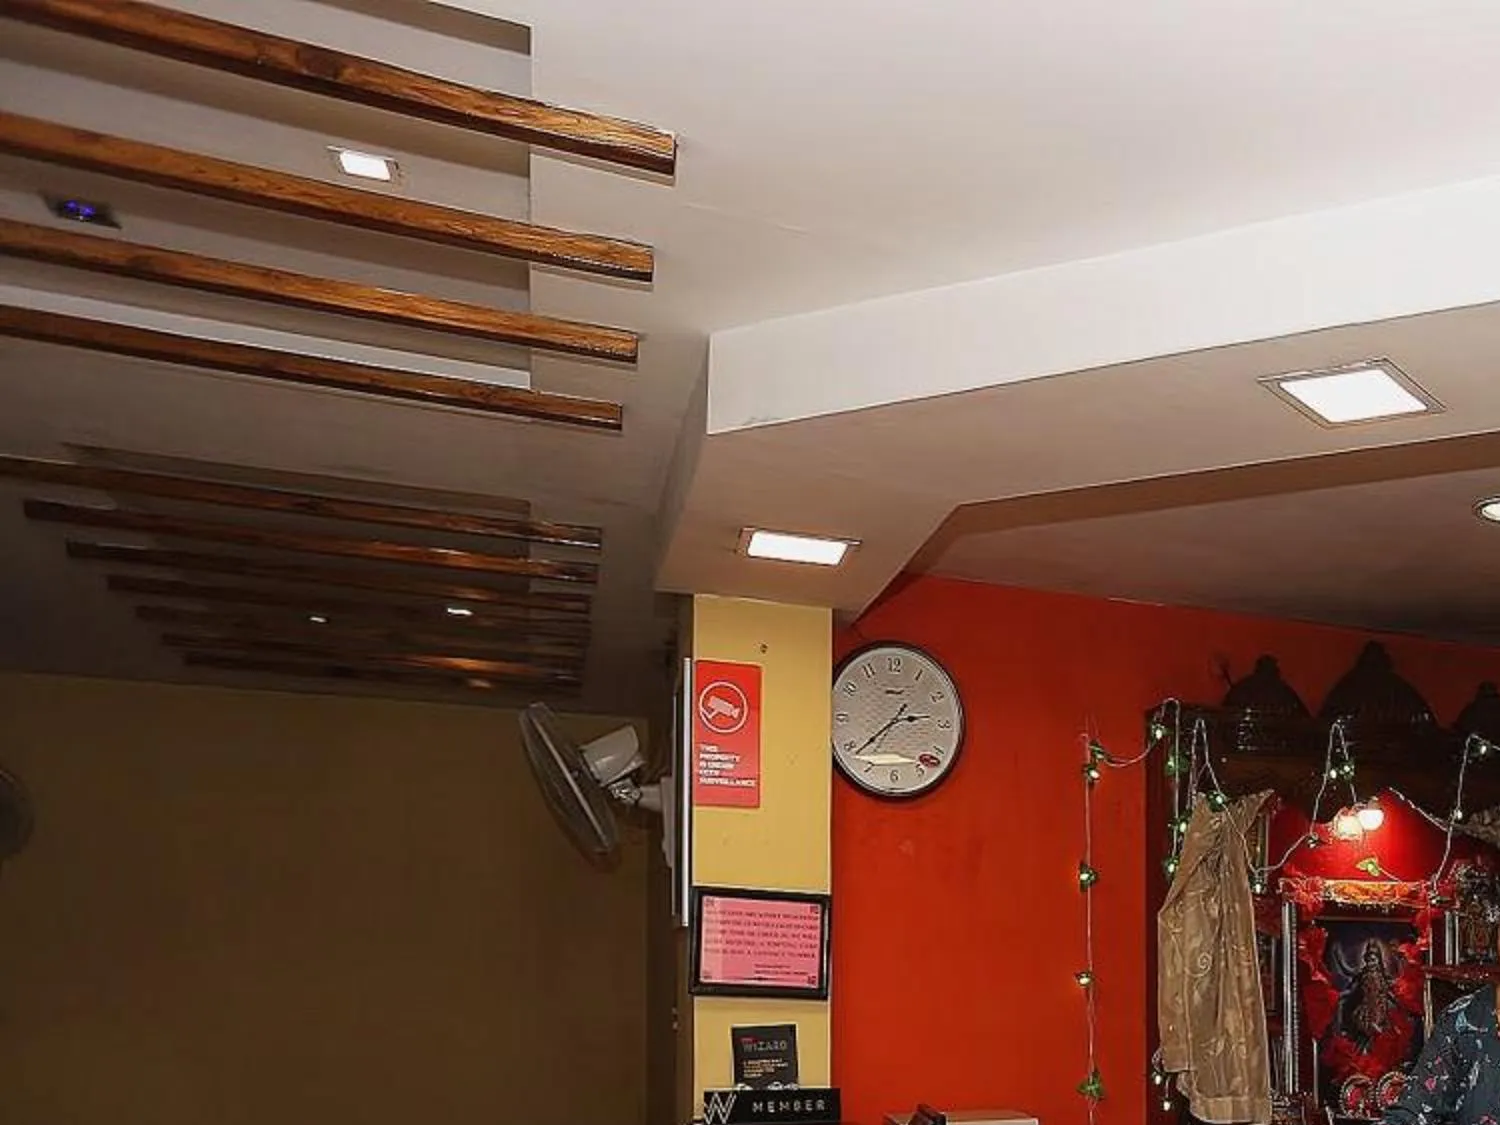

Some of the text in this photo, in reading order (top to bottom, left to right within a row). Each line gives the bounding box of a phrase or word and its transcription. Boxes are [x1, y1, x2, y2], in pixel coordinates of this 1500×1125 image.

[862, 663, 875, 679] 11
[888, 658, 901, 673] 12
[938, 720, 951, 730] 3
[890, 769, 899, 782] 6
[752, 1099, 826, 1114] MEMBER
